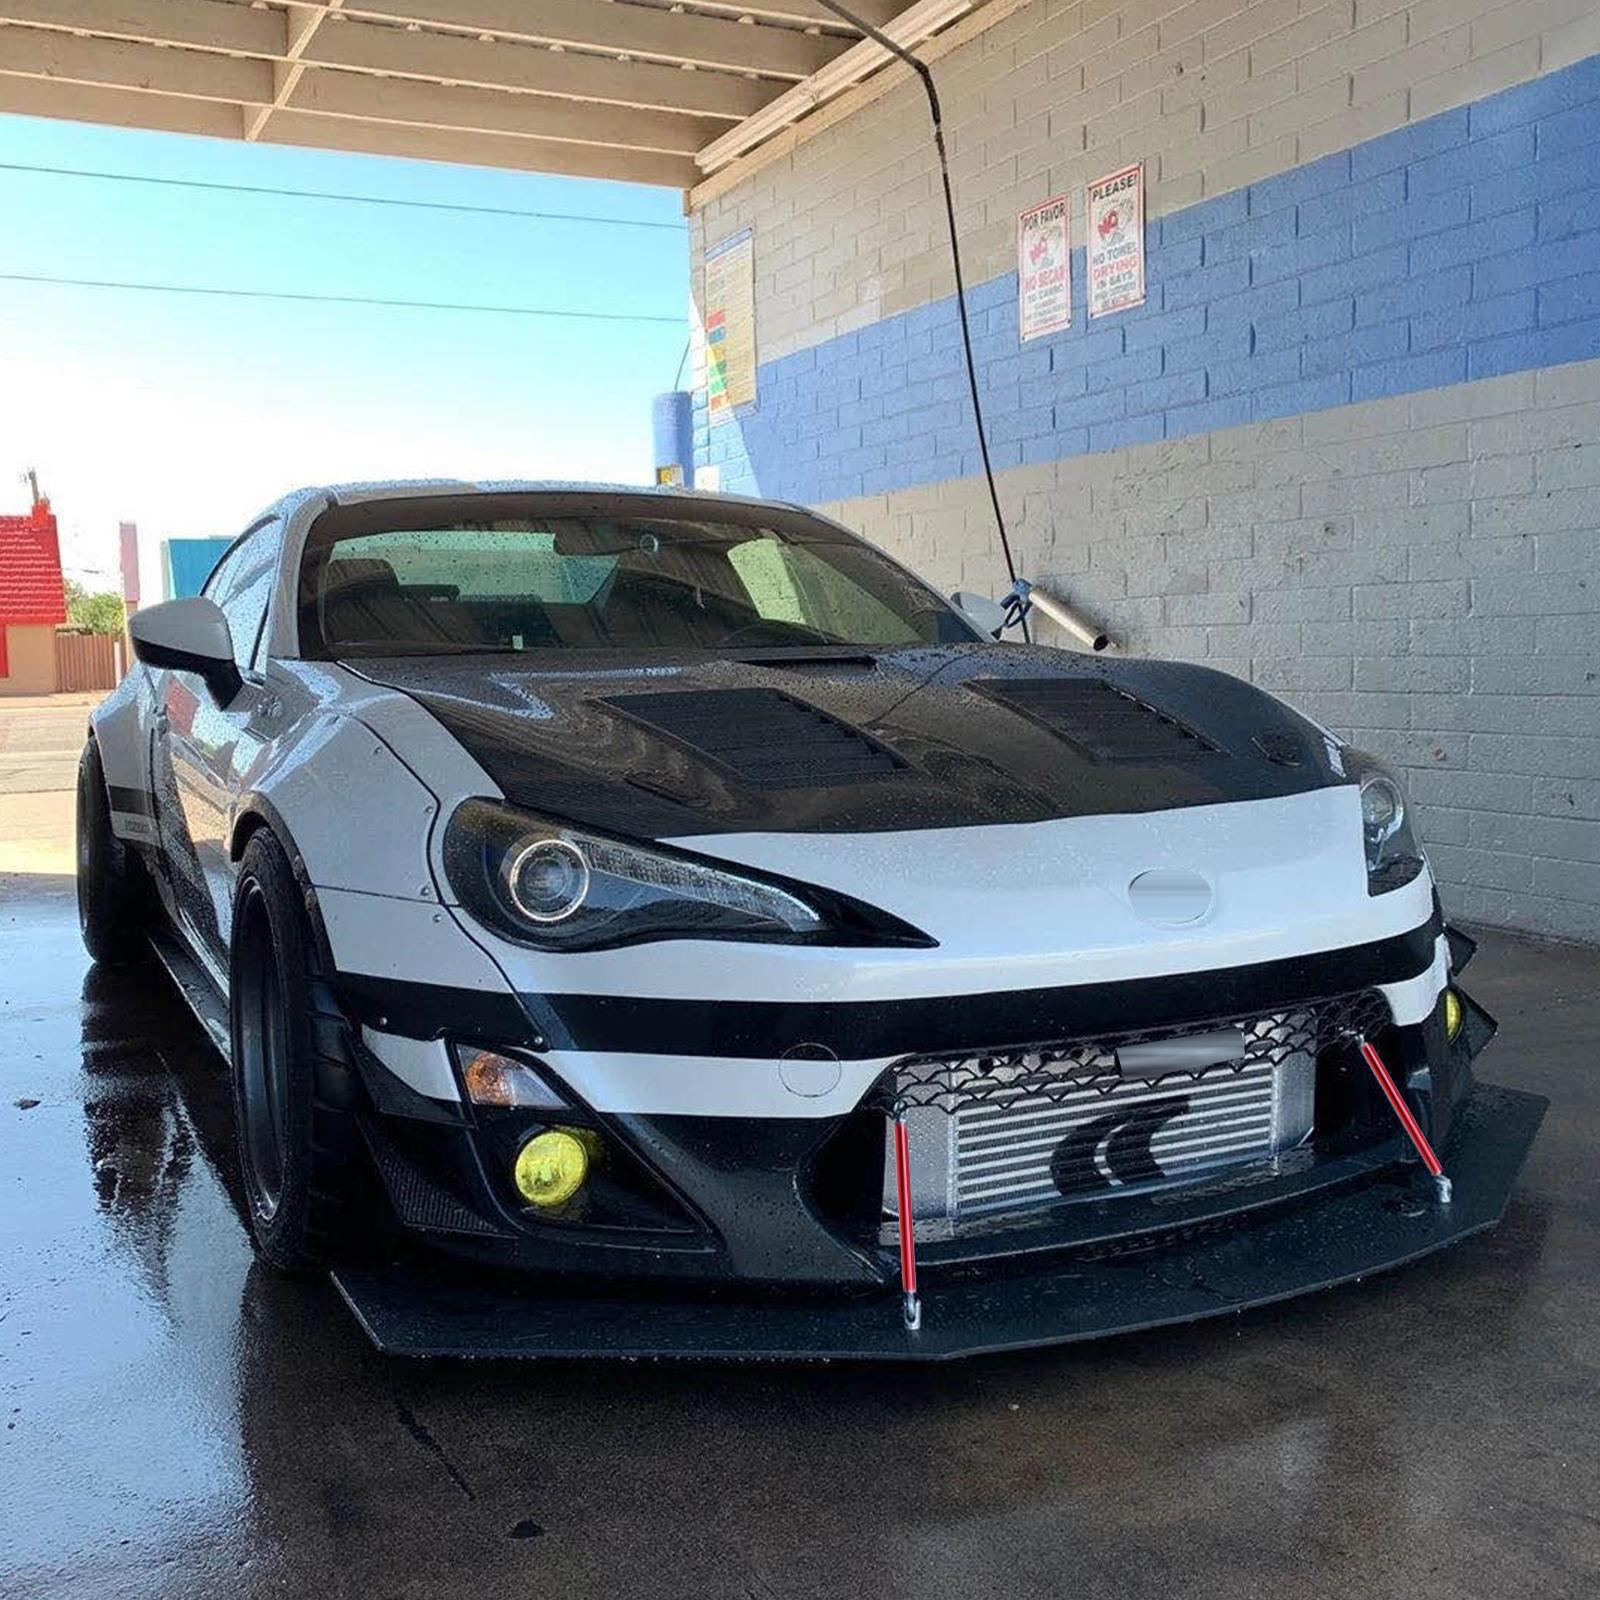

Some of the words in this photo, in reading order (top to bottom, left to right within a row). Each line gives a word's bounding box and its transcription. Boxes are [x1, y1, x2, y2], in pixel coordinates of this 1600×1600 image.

[1092, 173, 1137, 202] PLEASE!
[1040, 202, 1066, 226] FAVOR
[1093, 253, 1105, 266] NO
[1093, 256, 1137, 281] DRYING
